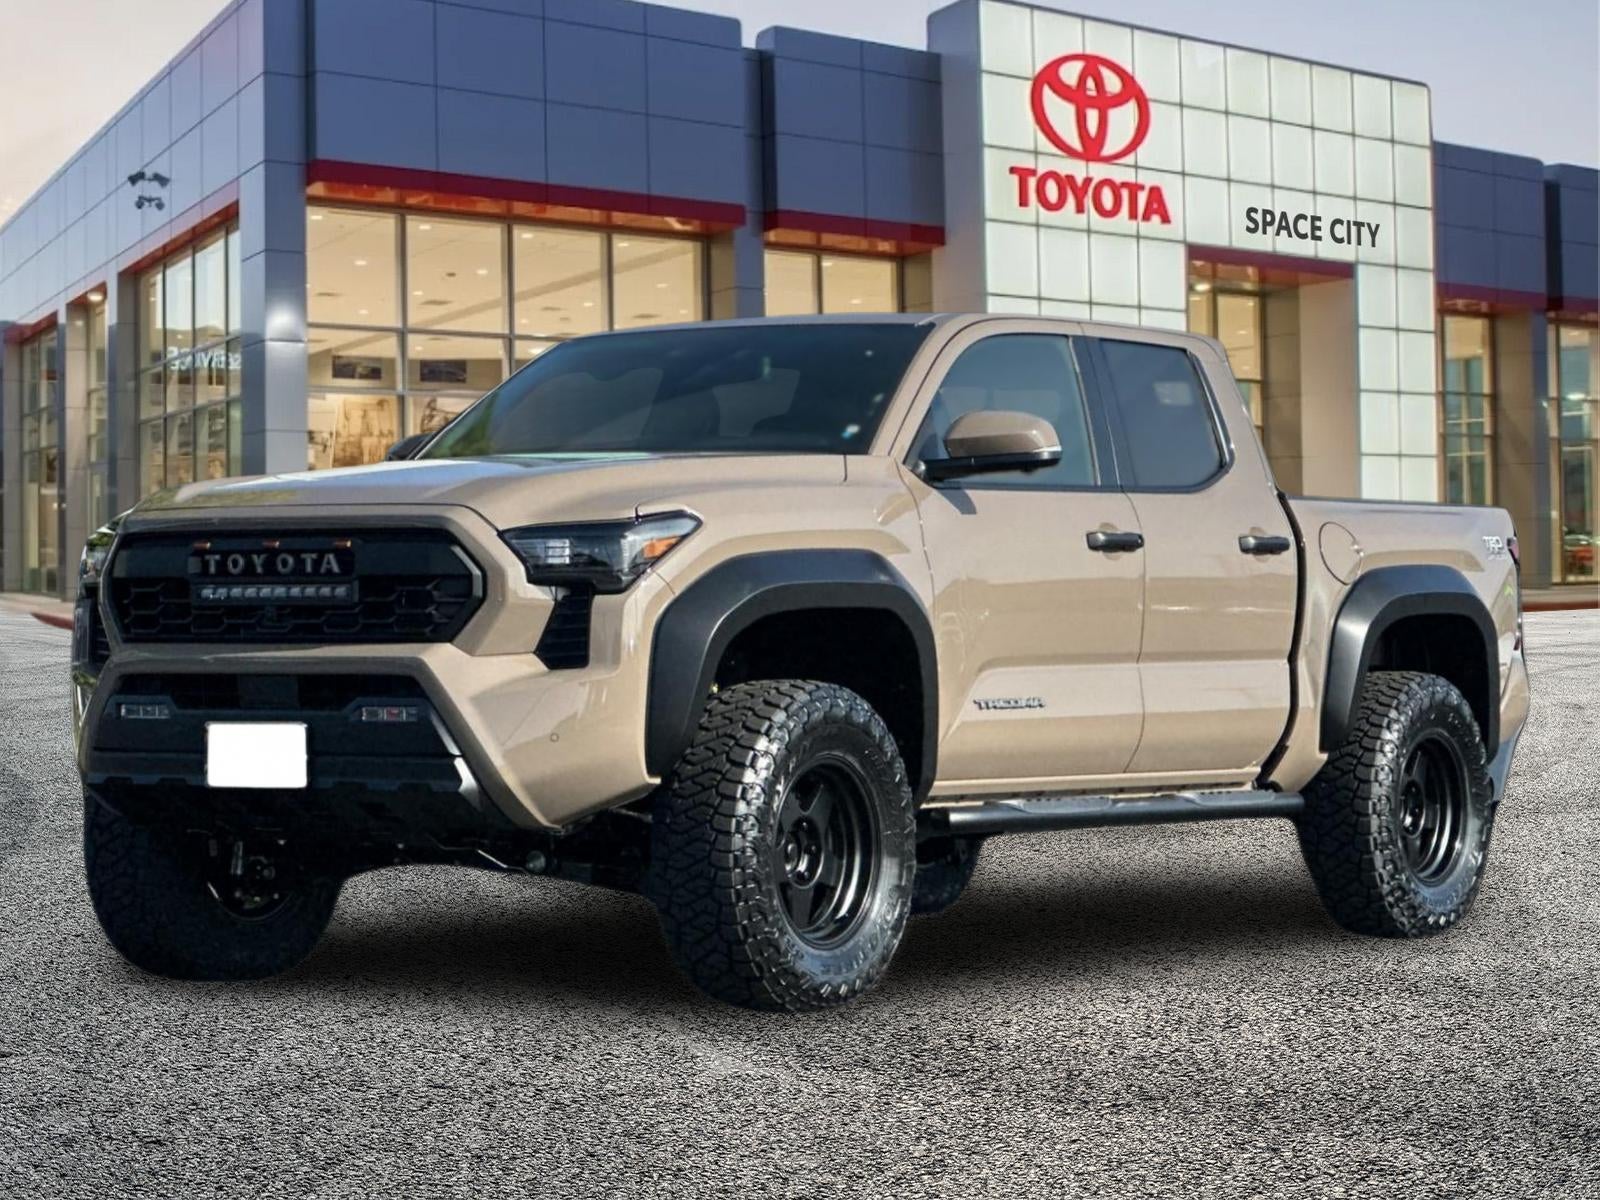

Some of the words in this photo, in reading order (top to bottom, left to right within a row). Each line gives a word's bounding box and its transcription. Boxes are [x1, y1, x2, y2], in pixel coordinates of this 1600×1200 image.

[1009, 166, 1171, 224] TOYOTA
[1245, 206, 1322, 241] SPACE
[1329, 218, 1380, 248] CITY
[204, 553, 341, 574] TOYOTA
[973, 697, 1046, 710] TACOMA
